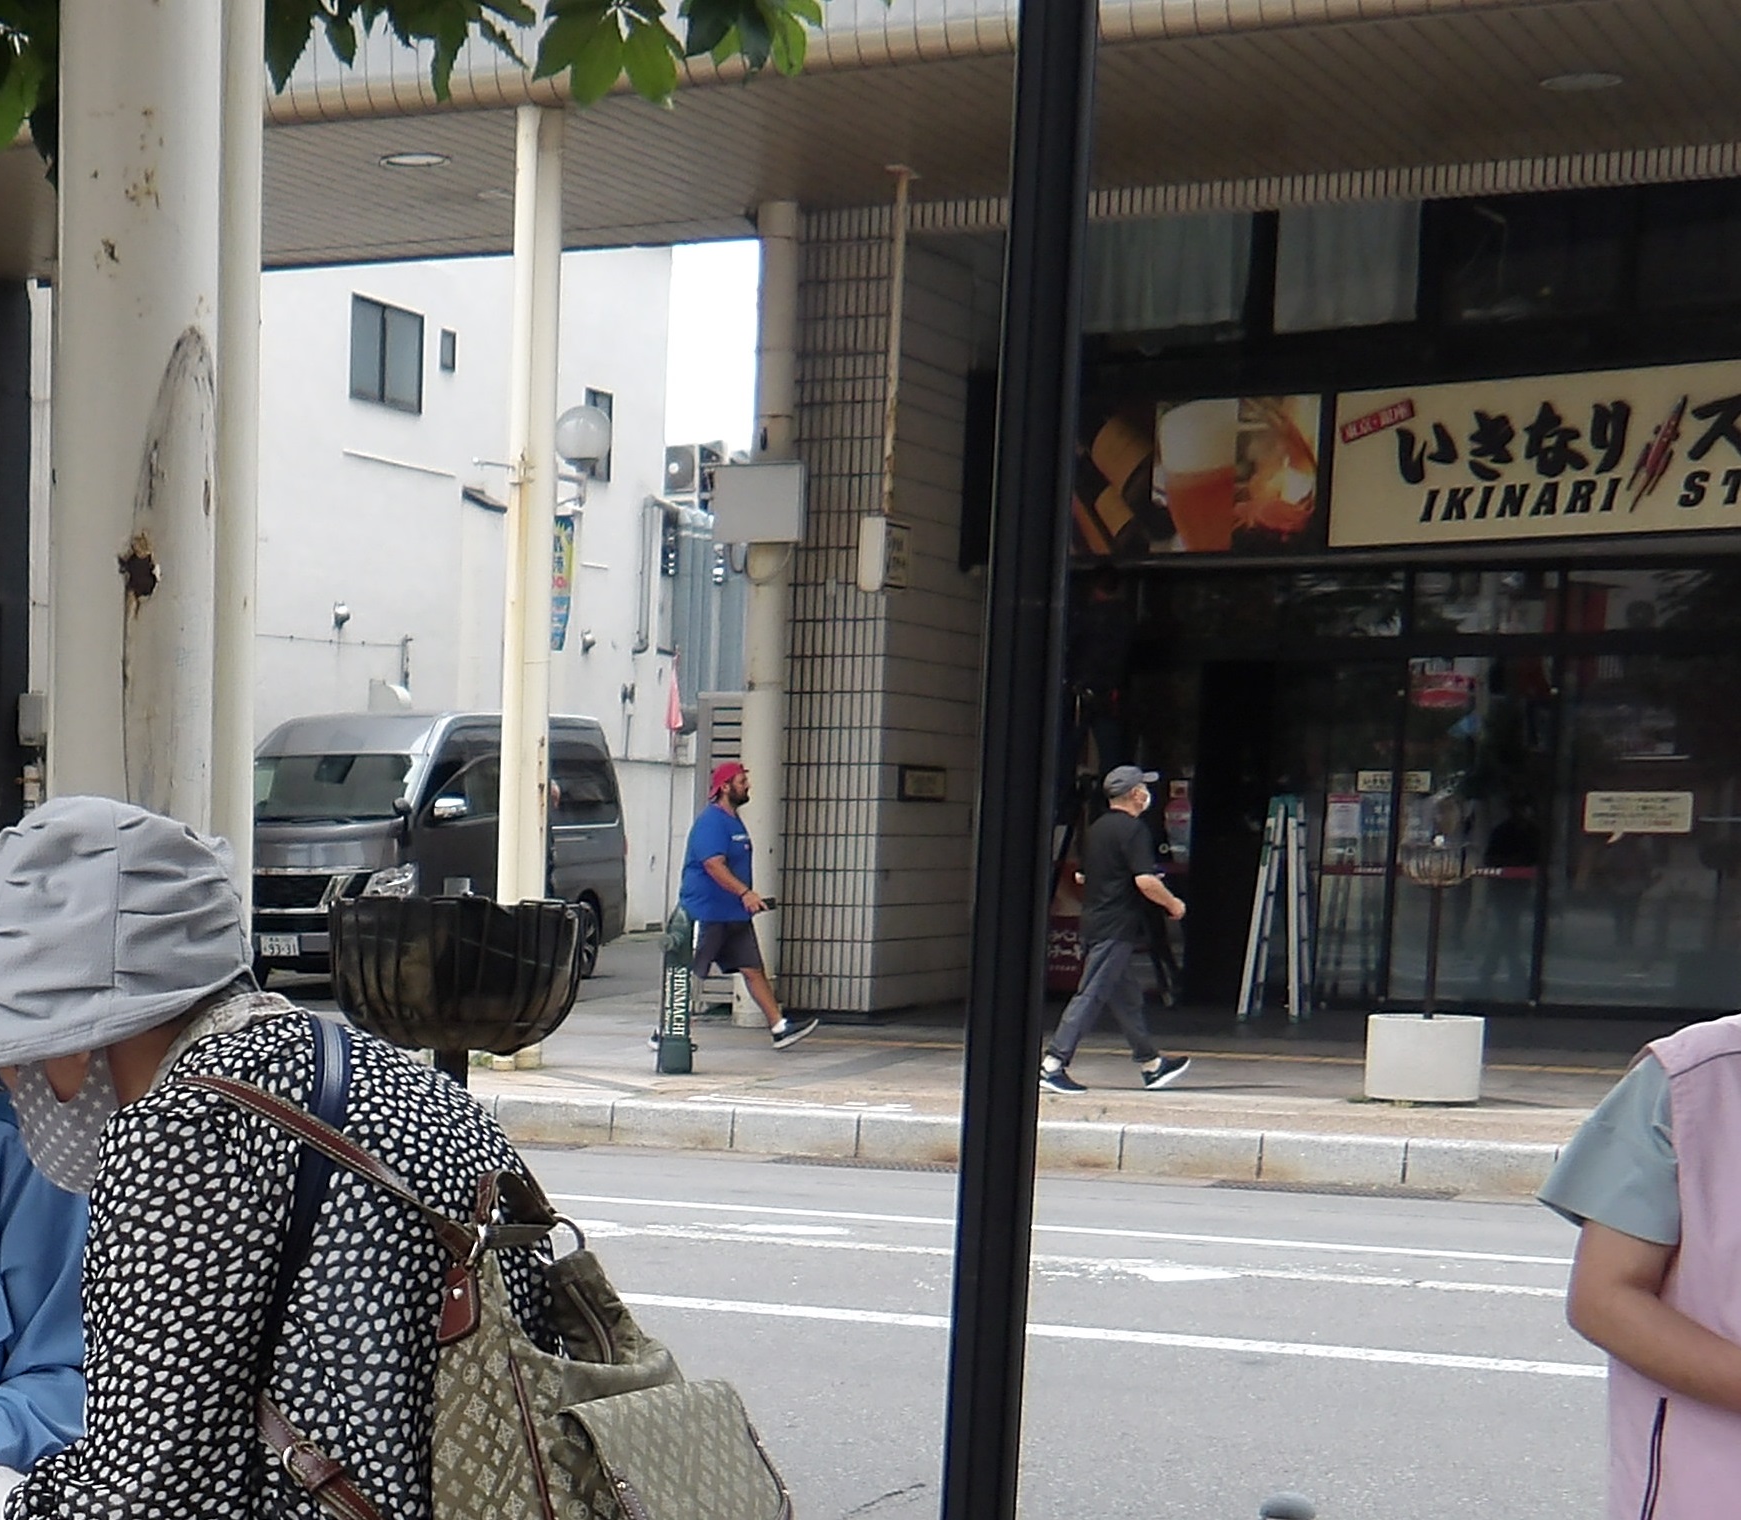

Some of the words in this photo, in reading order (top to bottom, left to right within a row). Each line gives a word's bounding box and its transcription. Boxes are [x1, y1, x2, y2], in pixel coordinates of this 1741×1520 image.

[1396, 401, 1632, 485] いきなり
[1419, 477, 1623, 523] IKINARI
[672, 967, 687, 1035] SHINMACHI
